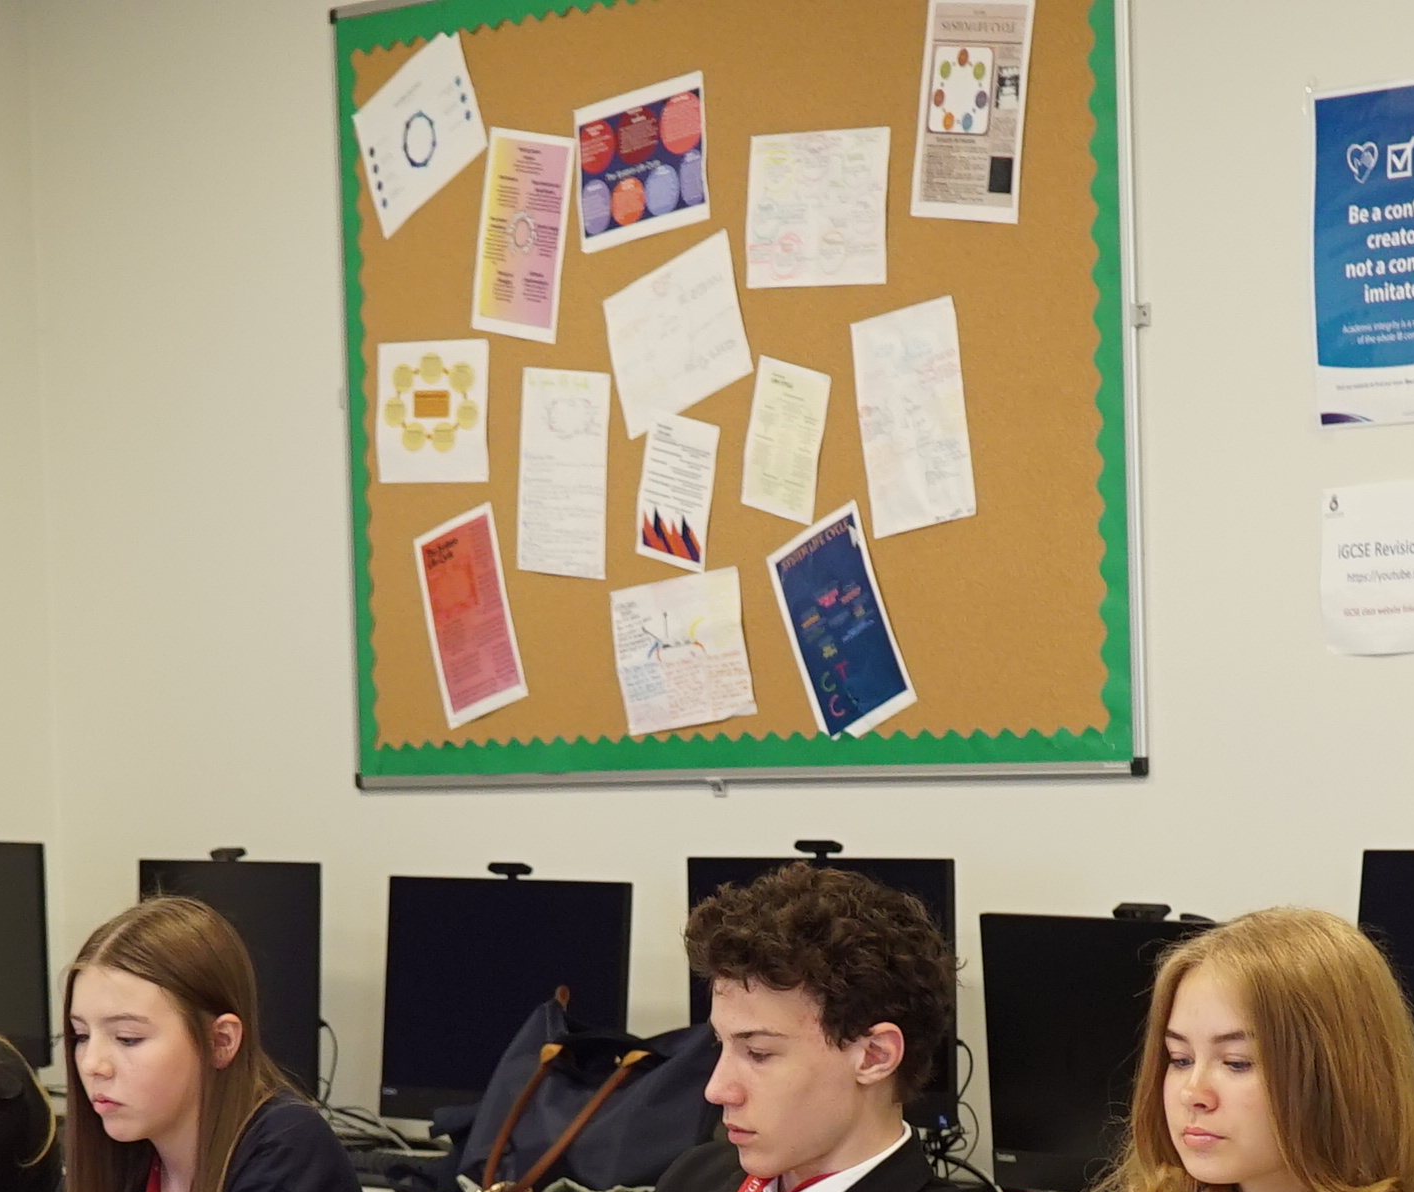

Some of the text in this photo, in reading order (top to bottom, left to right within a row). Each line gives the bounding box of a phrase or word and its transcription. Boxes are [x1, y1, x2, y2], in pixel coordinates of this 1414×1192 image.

[1348, 205, 1370, 225] Be
[1371, 206, 1383, 223] a
[1345, 259, 1373, 280] not
[1375, 261, 1387, 276] a
